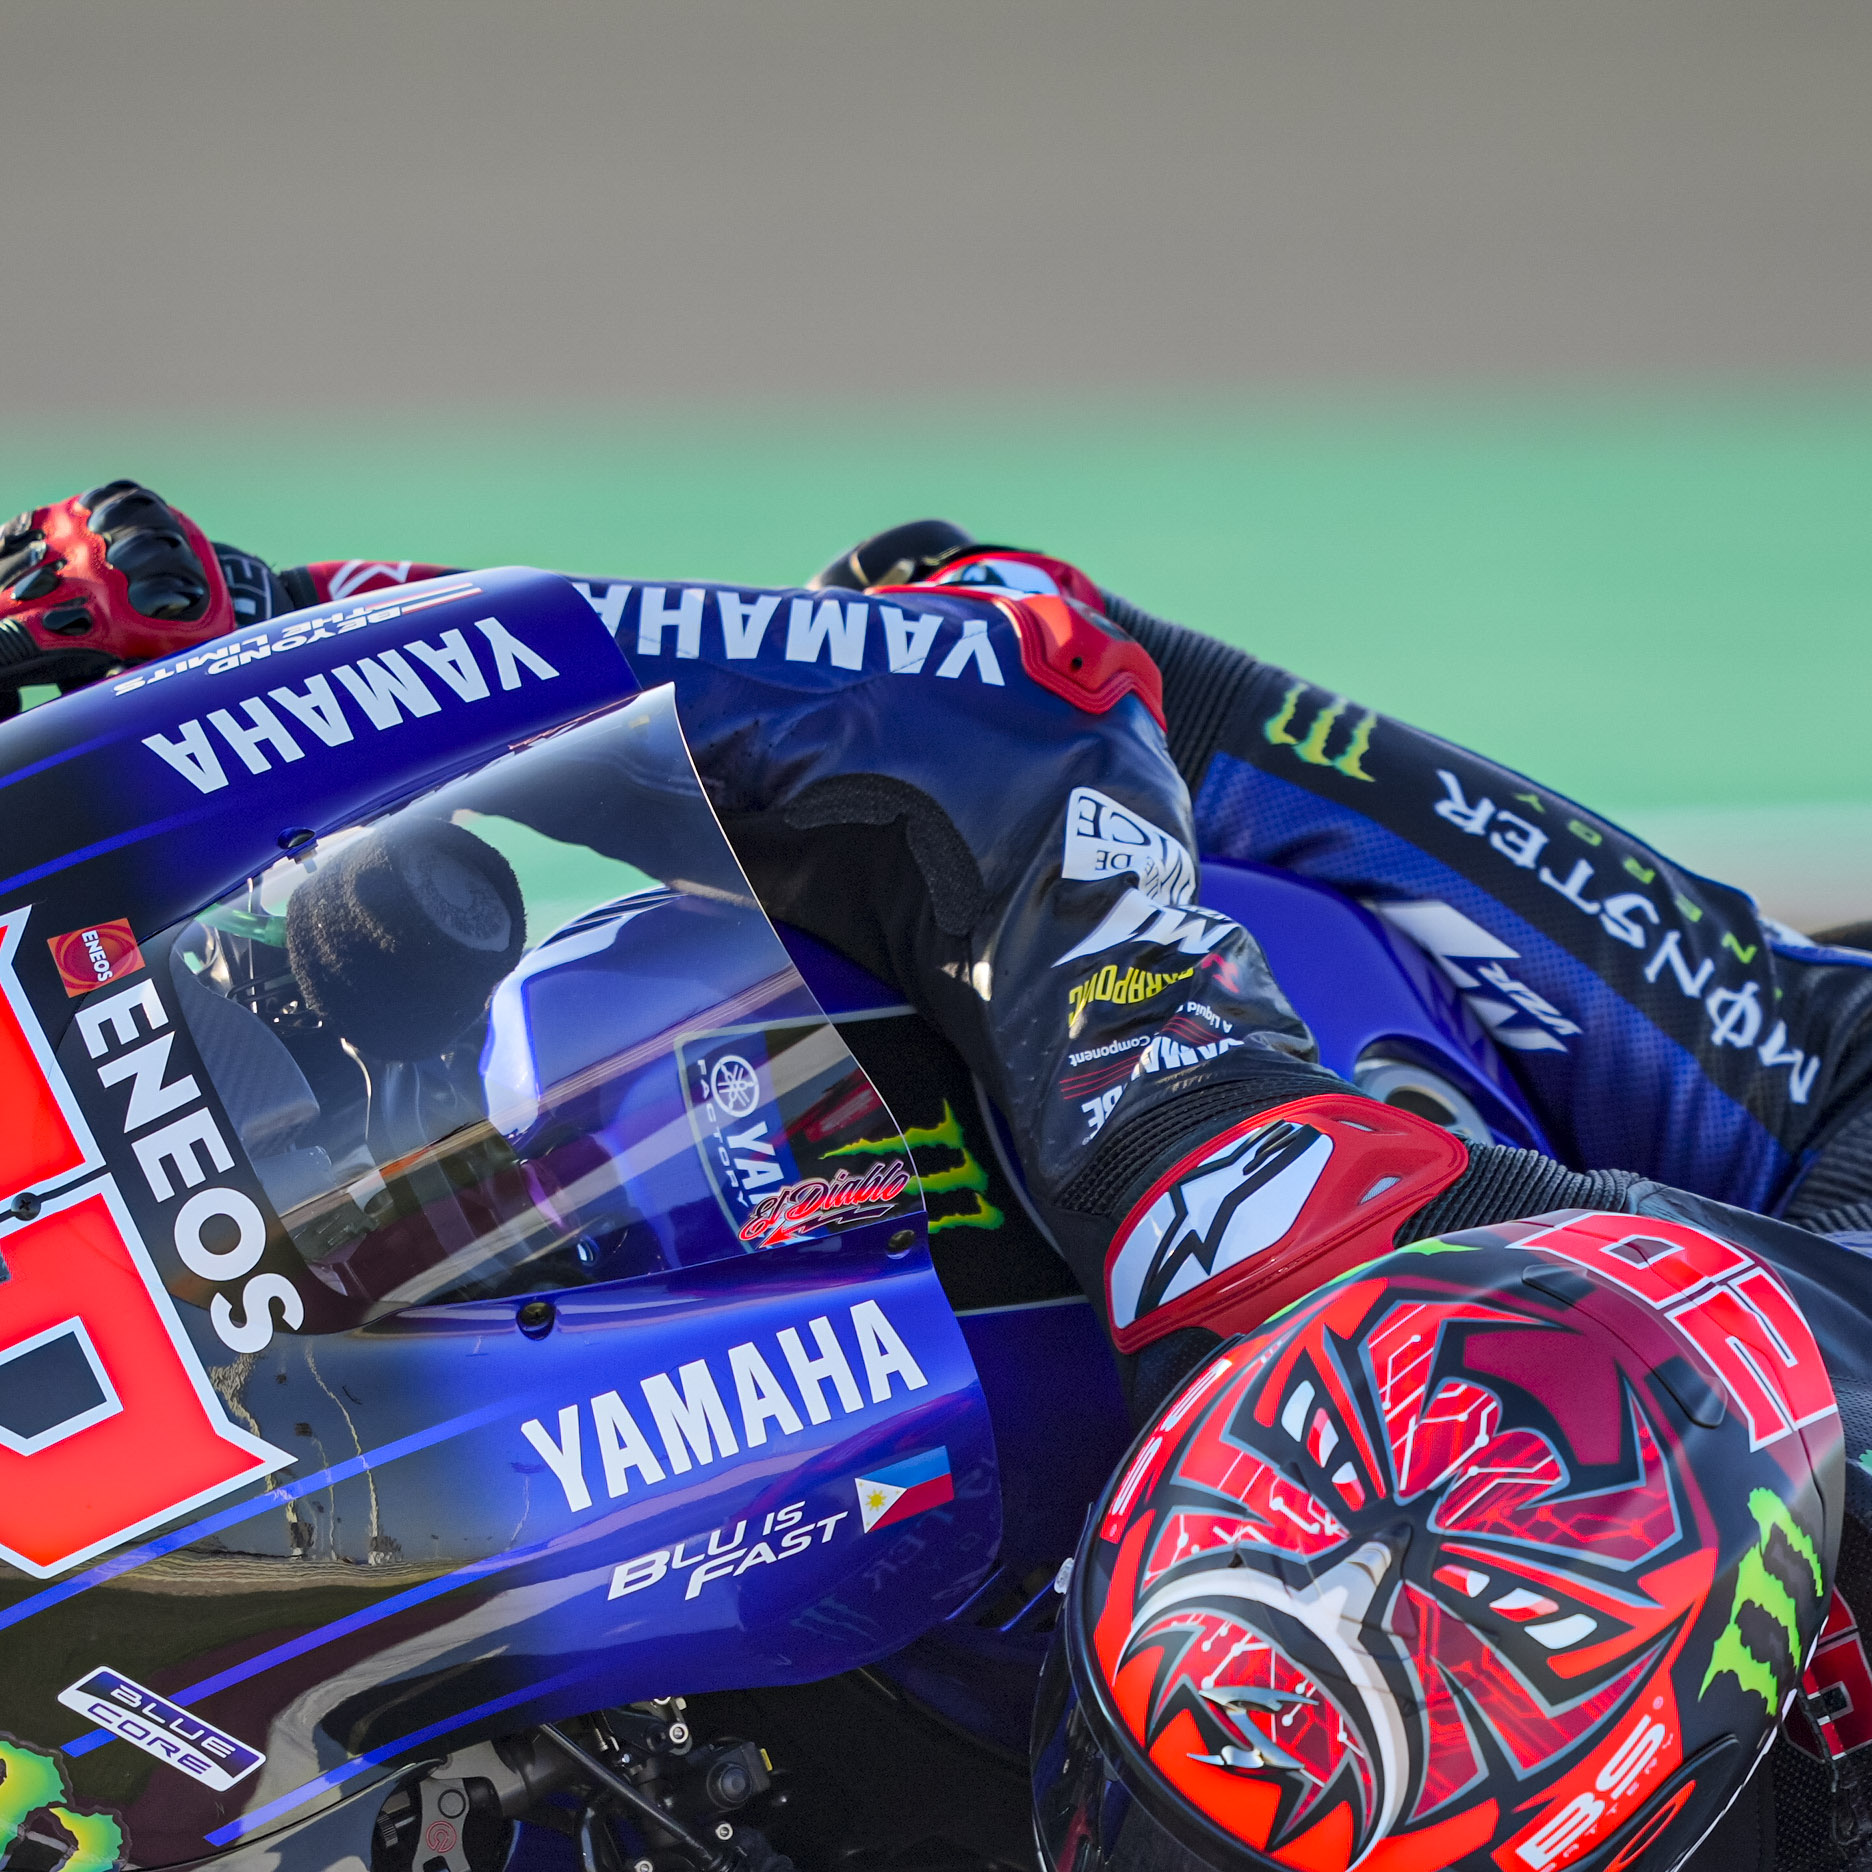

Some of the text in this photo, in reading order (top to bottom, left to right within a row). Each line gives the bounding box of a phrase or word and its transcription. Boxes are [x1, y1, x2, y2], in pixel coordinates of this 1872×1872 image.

[113, 607, 374, 696] THE LIMITS
[207, 606, 402, 675] BEYOND
[141, 616, 560, 794] YAMAHA
[1095, 850, 1134, 870] DE
[81, 929, 113, 982] ENEOS
[1069, 1036, 1151, 1067] Component
[1187, 1002, 1221, 1029] Liquid
[75, 978, 304, 1354] ENEOS
[697, 1059, 749, 1208] FACTORY
[738, 1186, 789, 1241] El
[785, 1159, 911, 1221] Diablo
[1505, 1212, 1838, 1453] 20
[521, 1300, 928, 1513] YAMAHA
[607, 1501, 806, 1601] BLU IS
[685, 1513, 849, 1601] FAST
[88, 1703, 212, 1775] CORE
[110, 1684, 236, 1758] BLUE
[1515, 1714, 1665, 1871] BS
